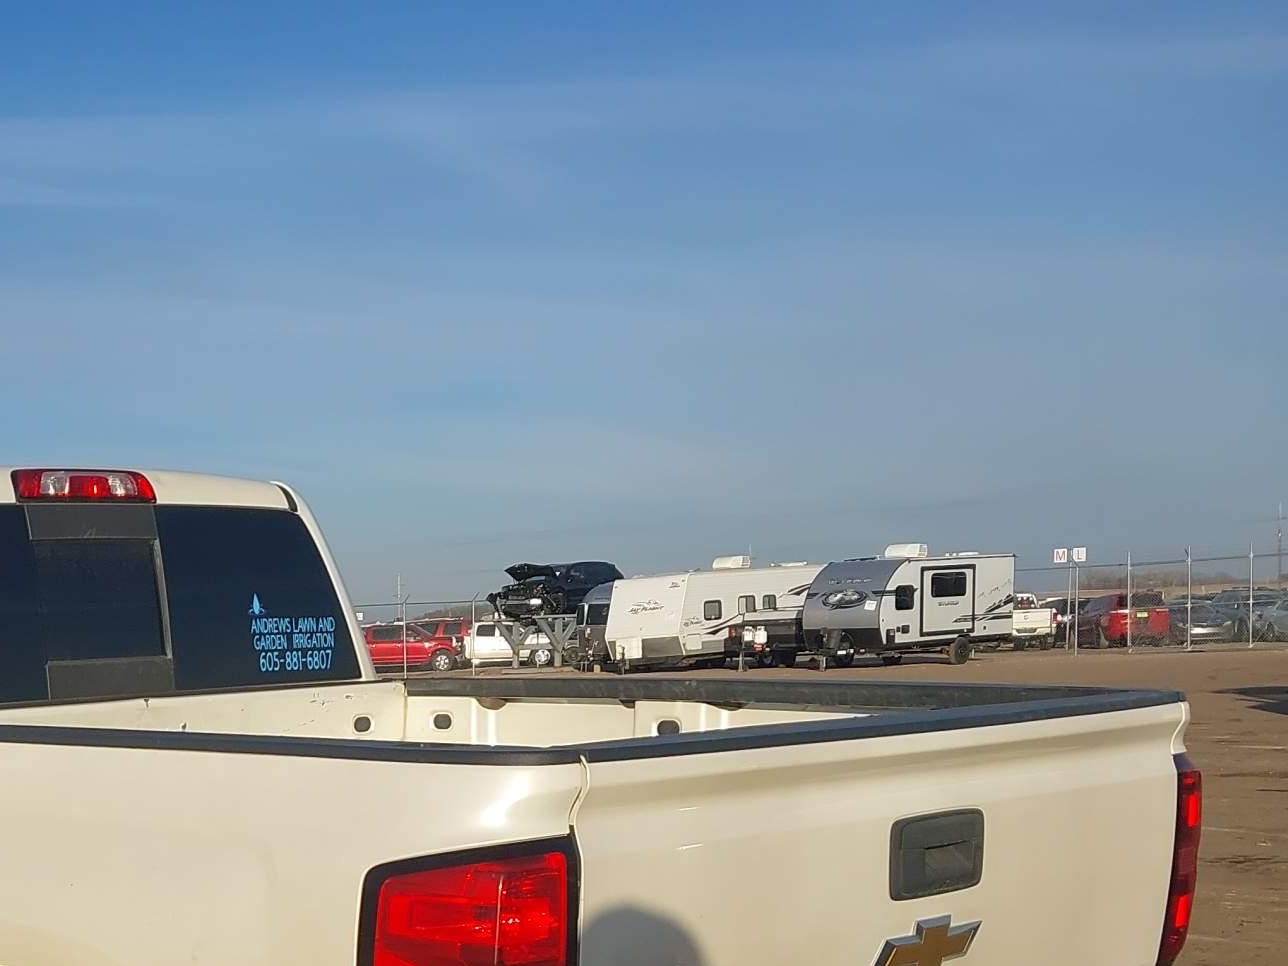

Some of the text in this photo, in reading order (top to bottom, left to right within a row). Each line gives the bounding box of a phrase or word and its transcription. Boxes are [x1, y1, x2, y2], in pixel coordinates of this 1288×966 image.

[251, 616, 336, 634] ANDREWS LAWN AND
[253, 632, 335, 650] GARDEN IRRIGATION
[259, 650, 332, 672] 605-881-6807
